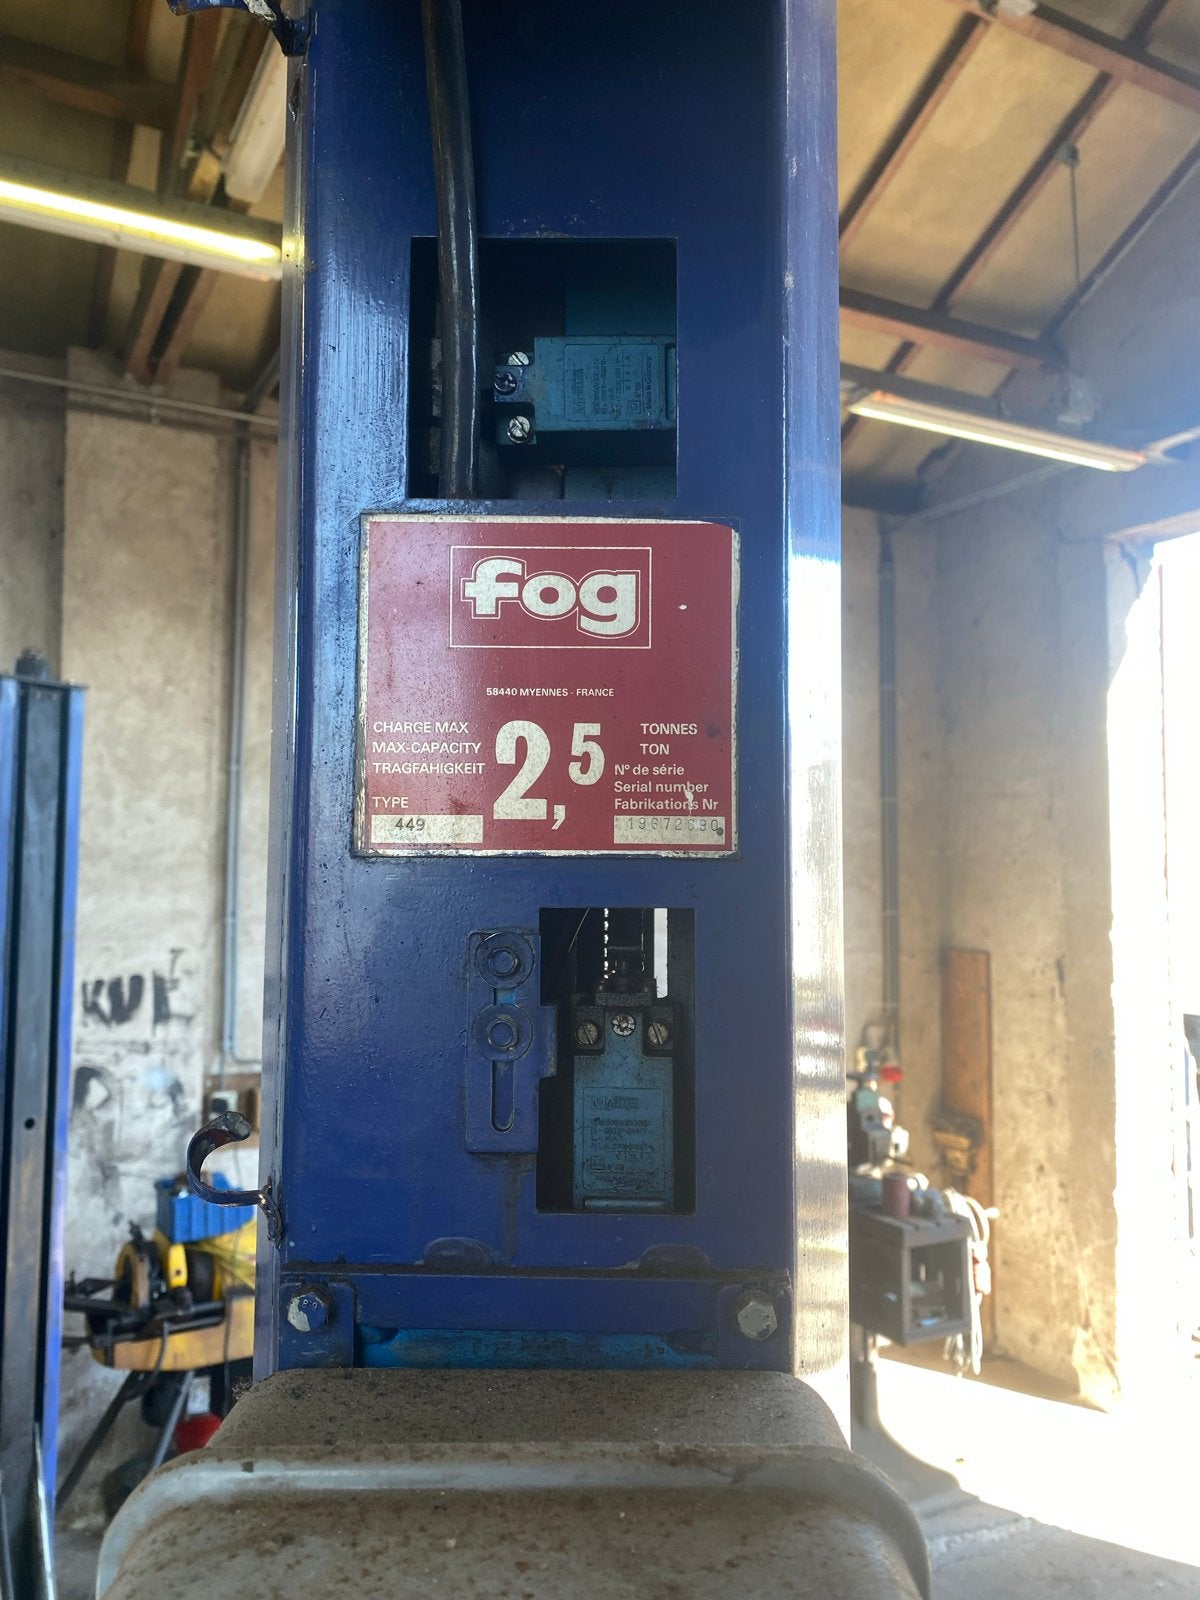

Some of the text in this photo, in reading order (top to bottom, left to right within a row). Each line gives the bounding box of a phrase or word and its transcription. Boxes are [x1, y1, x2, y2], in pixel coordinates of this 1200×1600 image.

[463, 558, 638, 637] fog
[486, 687, 518, 697] 58440
[519, 688, 569, 697] MYENNES
[576, 688, 615, 697] FRANCE
[373, 721, 469, 733] CHARGE MAX
[640, 723, 698, 735] TONNES
[372, 741, 482, 754] MAX-CAPACITY
[639, 743, 670, 755] TON
[372, 758, 486, 775] TRAGFÄHIGKEIT
[632, 764, 650, 776] de
[652, 763, 685, 776] série
[614, 781, 710, 793] Serial number
[372, 796, 409, 808] TYPE
[702, 798, 719, 810] Nr
[395, 817, 426, 831] 449
